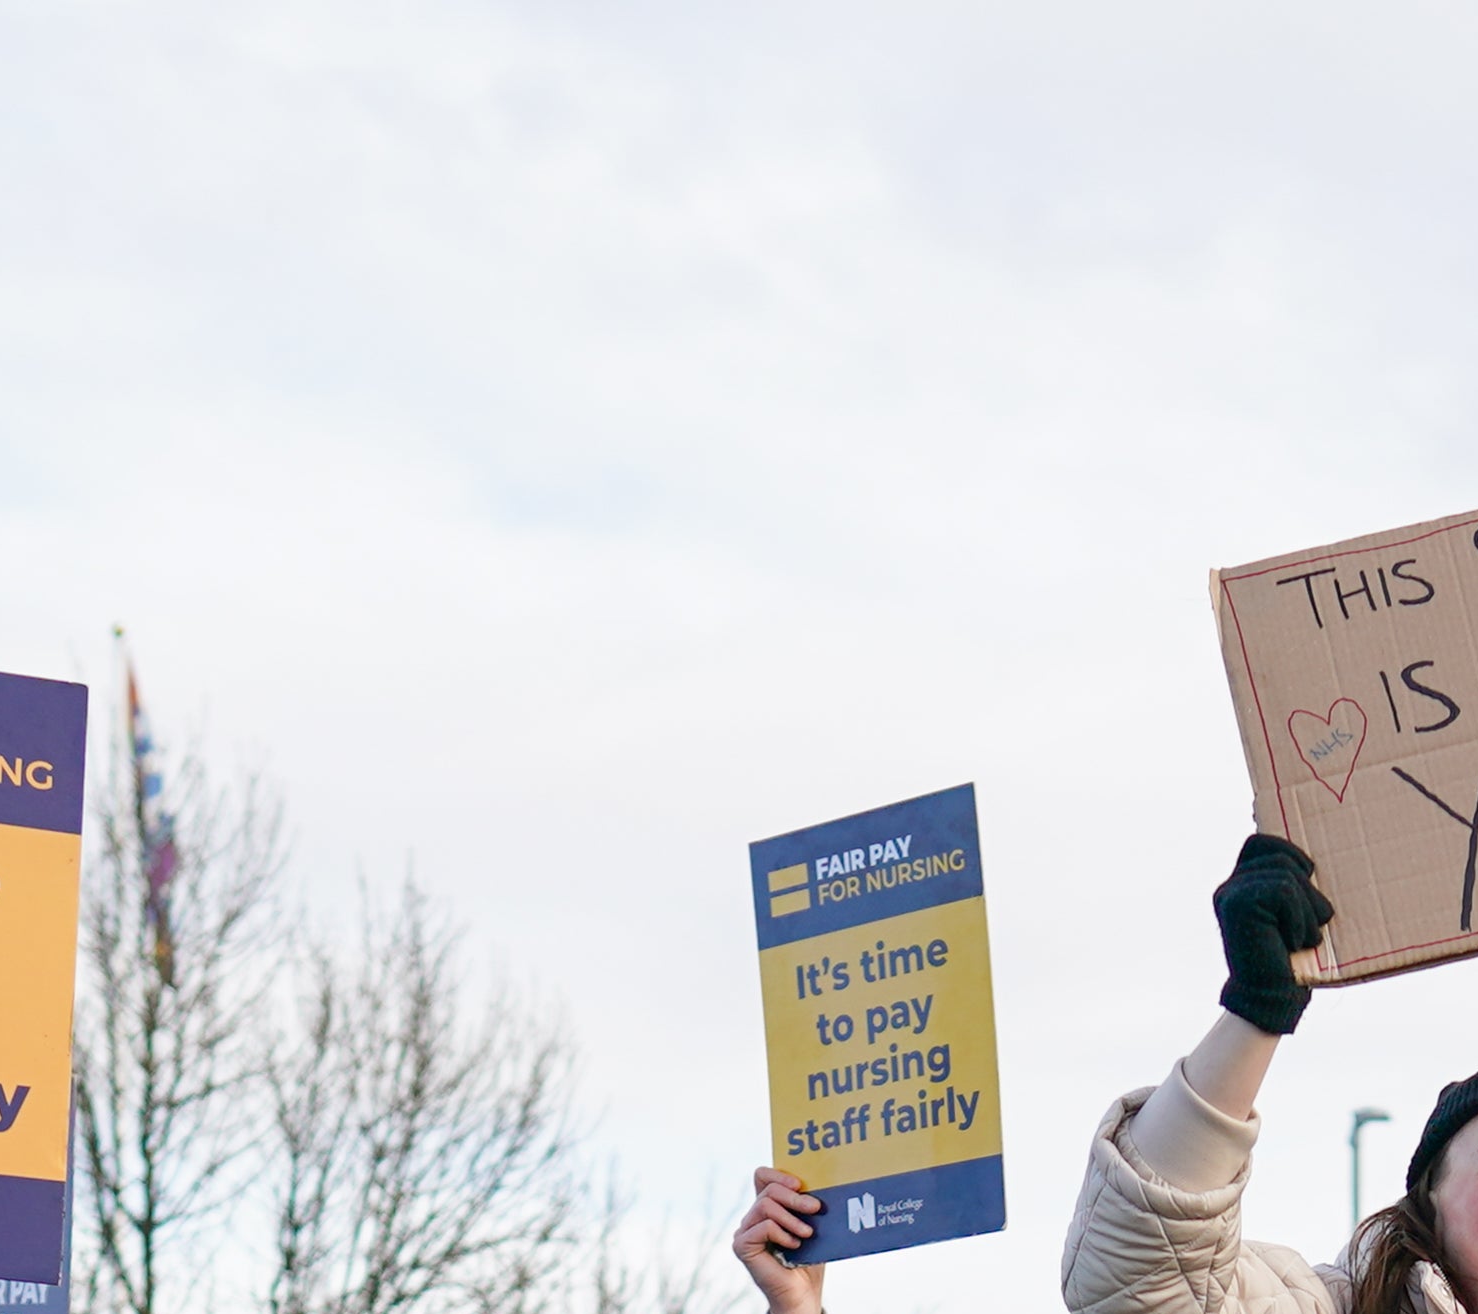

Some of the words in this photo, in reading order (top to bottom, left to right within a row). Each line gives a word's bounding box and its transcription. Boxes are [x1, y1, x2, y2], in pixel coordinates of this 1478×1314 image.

[1277, 558, 1435, 628] THIS
[1380, 660, 1461, 733] IS
[1308, 727, 1354, 763] NHS
[815, 848, 865, 880] FAIR
[869, 835, 912, 866] PAY
[819, 876, 861, 906] FOR
[866, 849, 965, 894] NURSING
[860, 938, 948, 983] time
[817, 1012, 854, 1046] to
[866, 994, 934, 1044] pay
[807, 1043, 951, 1101] nursing
[787, 1103, 871, 1155] staff
[881, 1086, 980, 1136] fairly
[878, 1201, 896, 1214] Royal
[898, 1198, 923, 1212] College
[878, 1215, 886, 1226] of
[887, 1212, 914, 1224] Nursing
[10, 1280, 49, 1304] PAY
